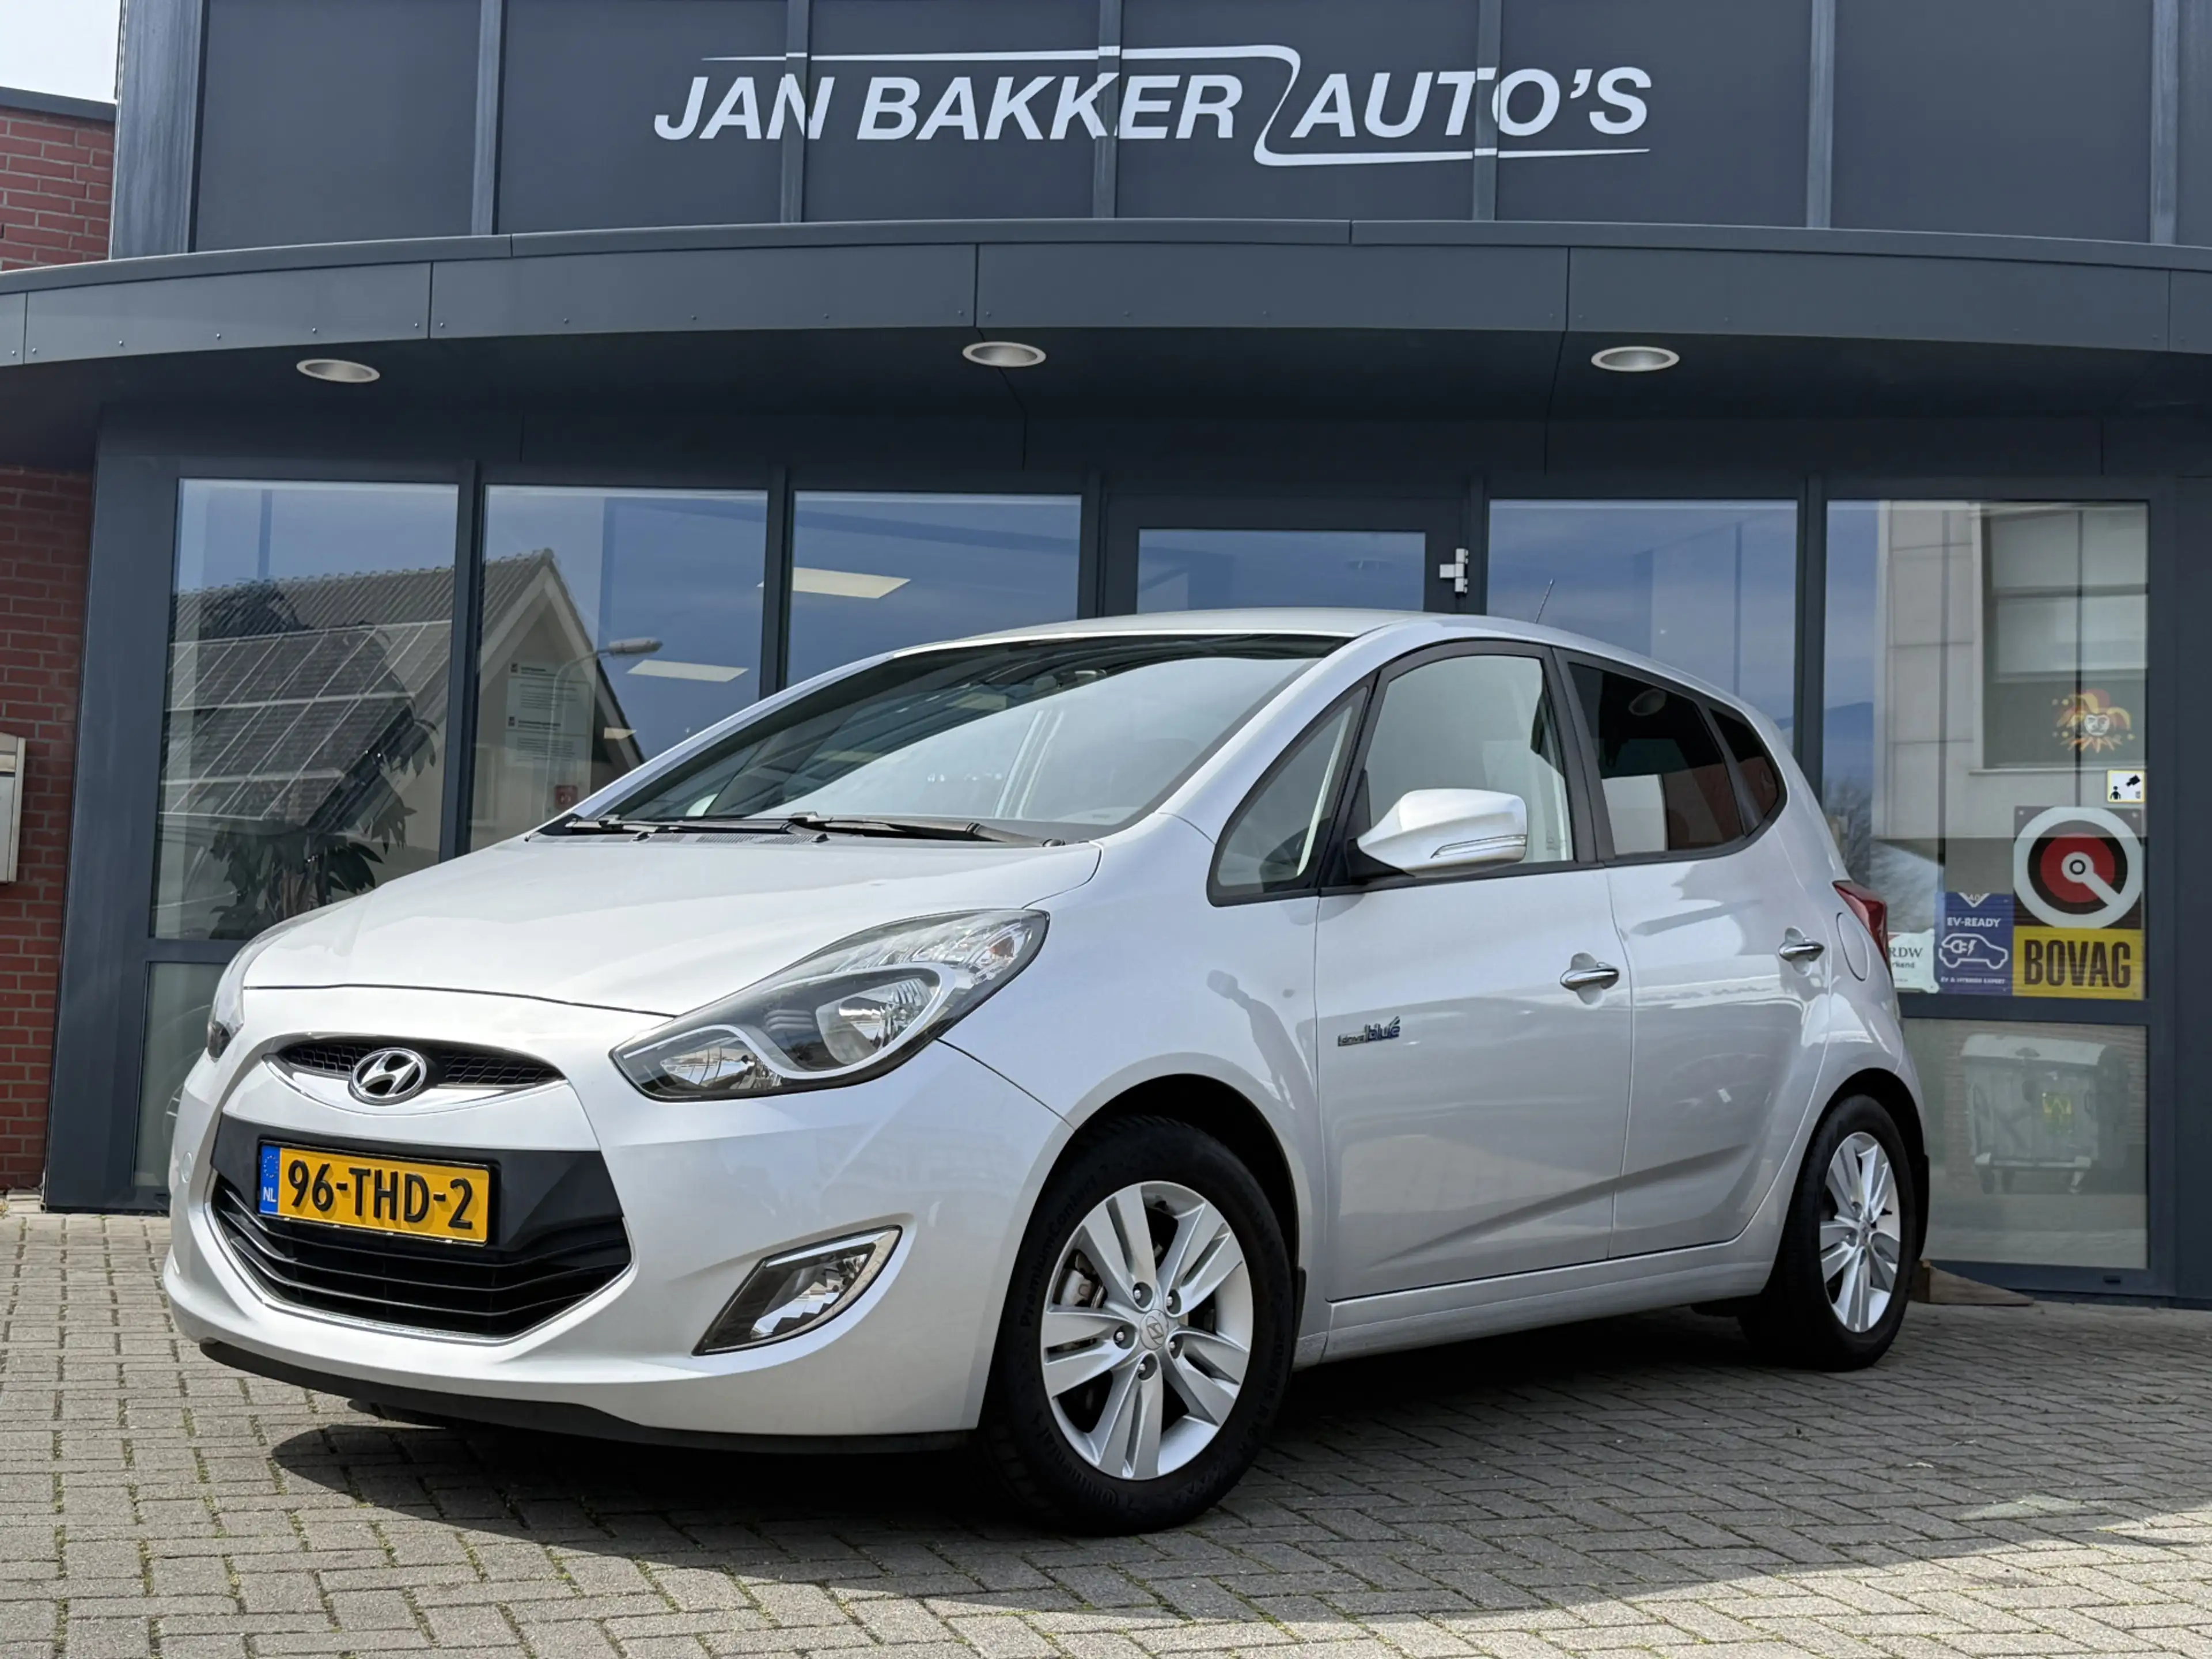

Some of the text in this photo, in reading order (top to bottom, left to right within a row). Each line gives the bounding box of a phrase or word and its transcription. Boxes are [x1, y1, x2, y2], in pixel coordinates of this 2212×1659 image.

[654, 66, 1652, 140] JAN BAKKER AUTO'S
[1946, 916, 2002, 928] EV-READY
[1889, 946, 1923, 957] RDW
[2024, 939, 2131, 988] BOVAG
[263, 1187, 277, 1202] NL
[288, 1160, 472, 1230] 96-THD-2
